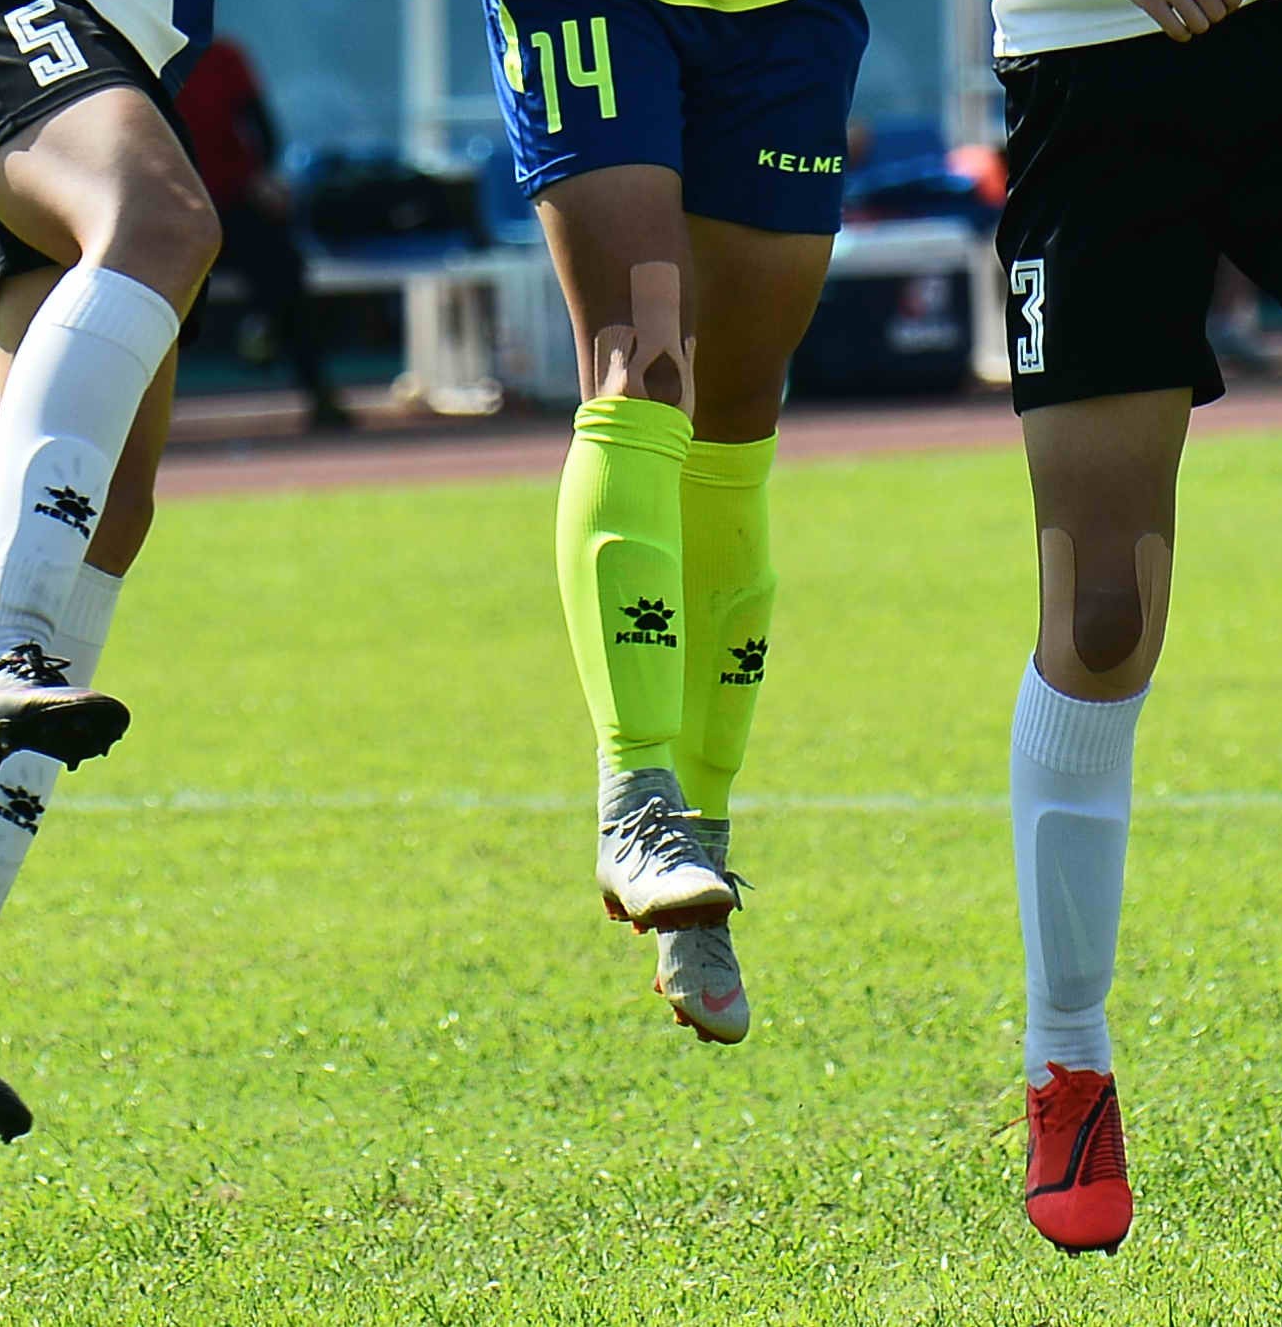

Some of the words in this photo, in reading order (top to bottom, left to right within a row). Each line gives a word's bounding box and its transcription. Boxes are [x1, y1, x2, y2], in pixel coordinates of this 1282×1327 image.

[531, 16, 618, 134] 14
[758, 148, 843, 175] KELME
[1011, 258, 1045, 374] 3
